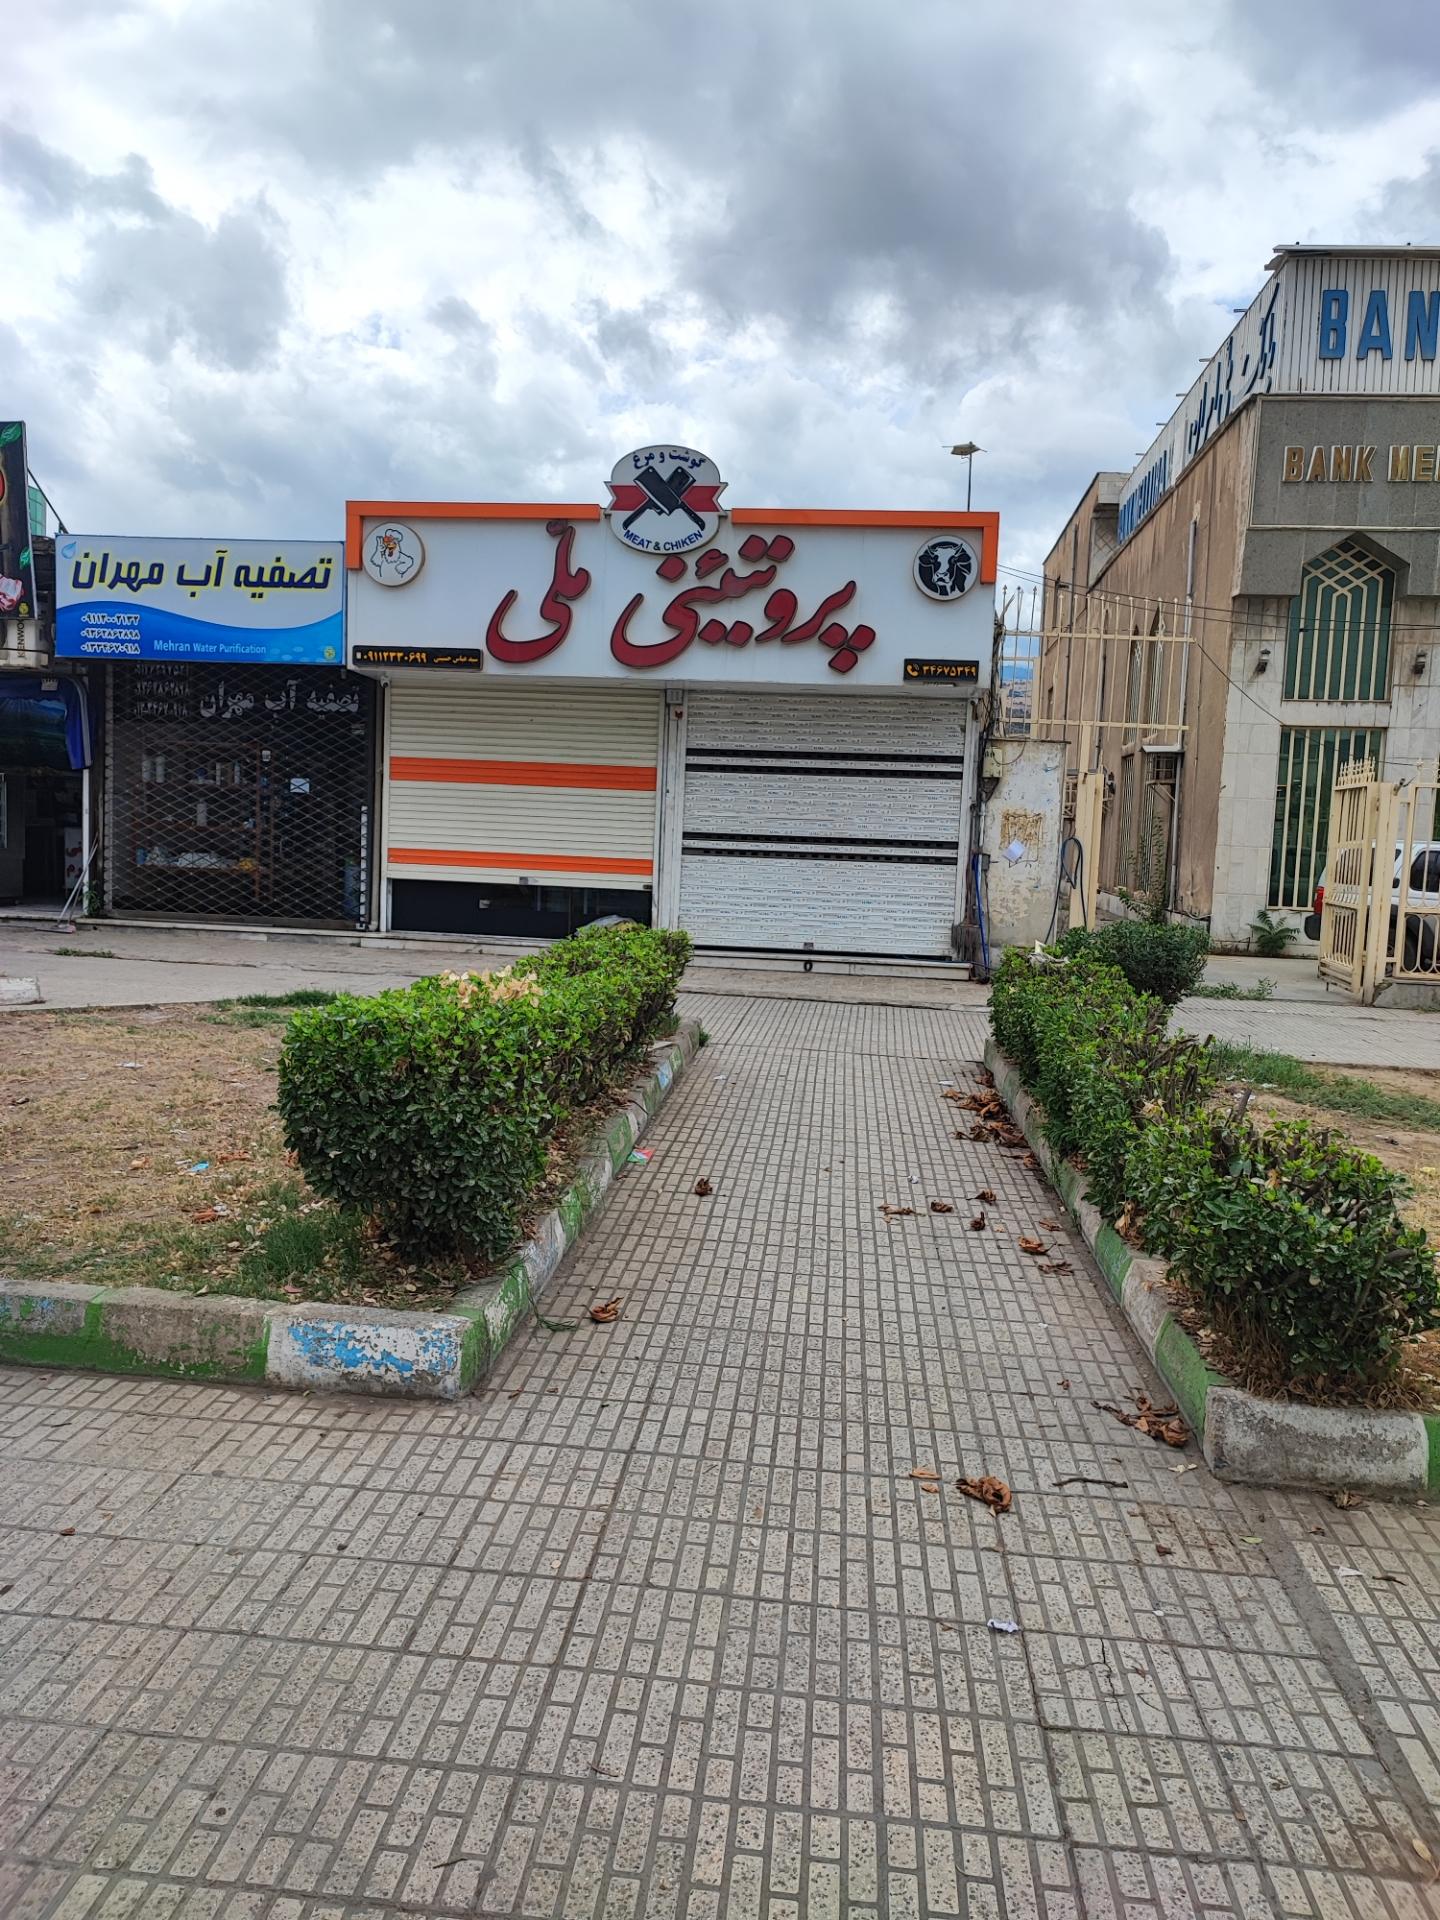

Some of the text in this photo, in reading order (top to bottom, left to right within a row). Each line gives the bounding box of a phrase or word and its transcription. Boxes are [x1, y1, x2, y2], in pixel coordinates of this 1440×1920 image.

[632, 449, 707, 470] گوشت و مرغ
[1281, 445, 1440, 483] BANK ME
[623, 529, 703, 551] MEAT & CHIKEN
[71, 549, 333, 599] تصفیه آب مهران
[612, 532, 875, 675] پروتئینی
[16, 619, 26, 658] KENWO
[153, 640, 266, 655] Mehran Water Purification
[199, 680, 255, 719] مهران
[264, 679, 302, 724] آب
